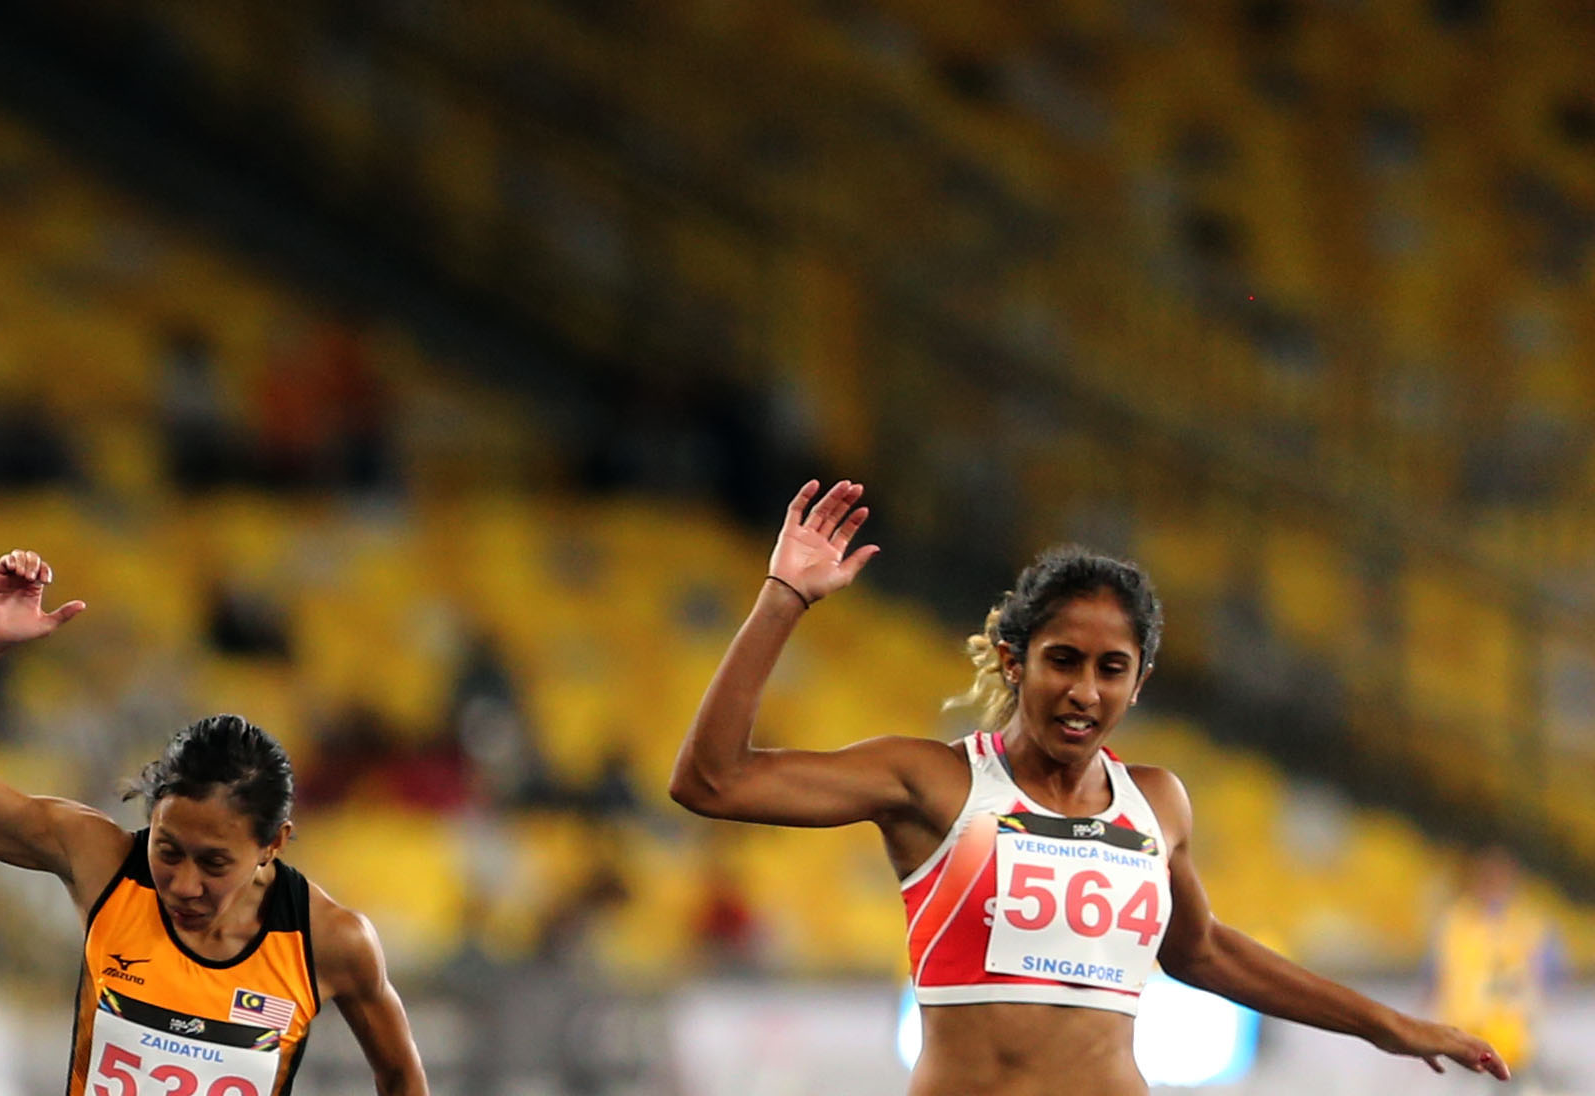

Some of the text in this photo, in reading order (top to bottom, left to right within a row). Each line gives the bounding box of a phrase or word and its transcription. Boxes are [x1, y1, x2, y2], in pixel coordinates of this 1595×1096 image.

[1014, 839, 1153, 870] VERONICA SHANTI
[1004, 863, 1162, 946] 564
[1022, 956, 1124, 983] SINGAPORE
[140, 1033, 223, 1063] ZAIDATUL
